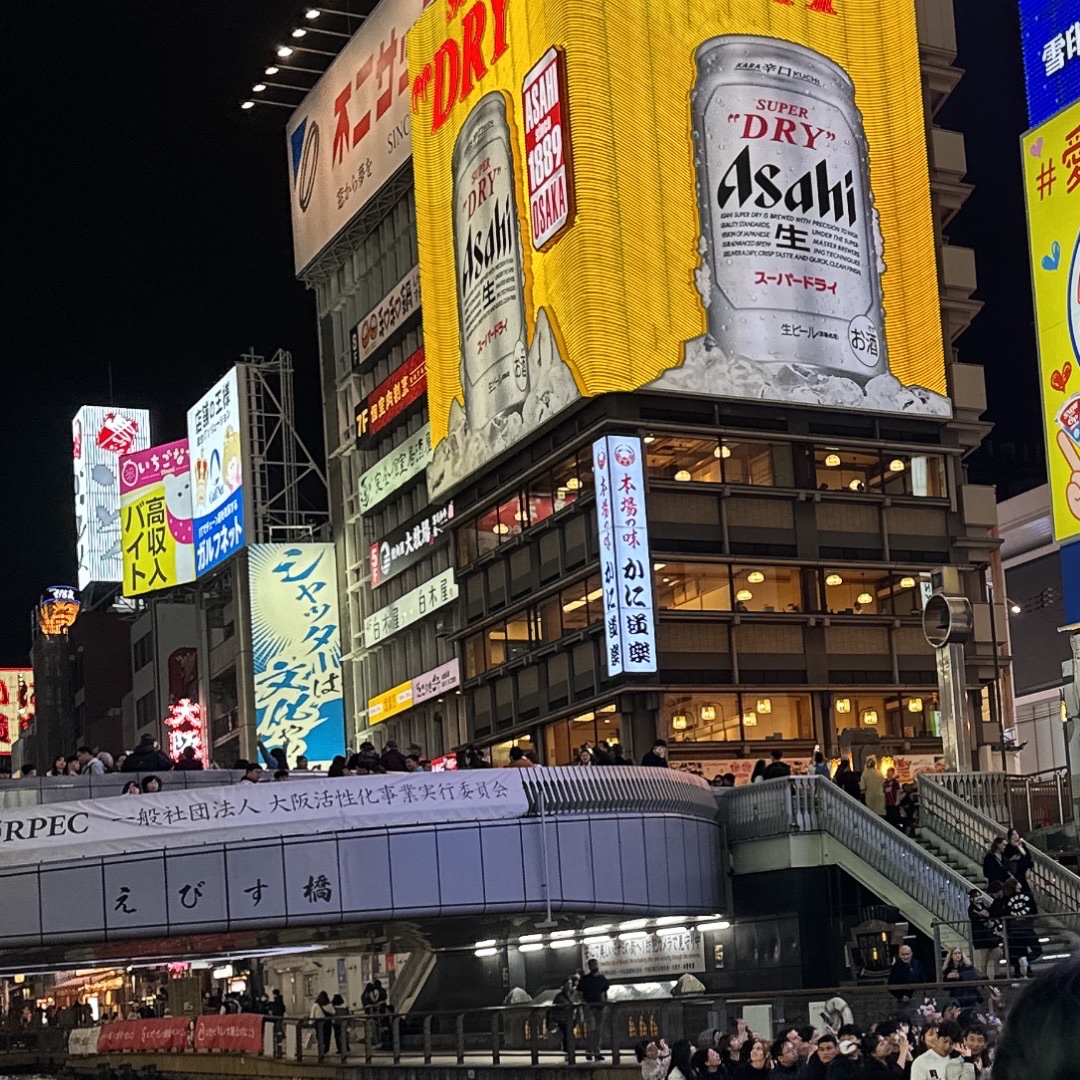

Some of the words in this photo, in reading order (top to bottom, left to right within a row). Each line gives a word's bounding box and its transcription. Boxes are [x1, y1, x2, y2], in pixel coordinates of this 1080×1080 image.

[525, 60, 560, 134] ASAHI
[756, 99, 809, 120] SUPER
[528, 124, 562, 192] 1889
[717, 144, 857, 227] Asahi
[532, 175, 566, 240] OSAKA
[463, 193, 513, 298] Asahi
[774, 223, 811, 253] 生
[755, 272, 837, 295] スーパードライ
[850, 328, 879, 357] お酒
[356, 408, 369, 438] 7F
[138, 447, 189, 475] いちごな
[618, 473, 641, 549] 本場の味
[125, 500, 146, 591] バイト
[146, 496, 168, 587] 高収入
[197, 515, 242, 571] ガルフネット
[373, 606, 400, 641] 白木屋
[418, 577, 449, 615] 白木屋
[622, 558, 651, 664] かに道楽
[0, 812, 89, 843] RPEC
[111, 799, 261, 827] 一般社団法人
[269, 780, 508, 813] 大阪活性化事業実行委員会
[115, 874, 332, 914] えびす橋
